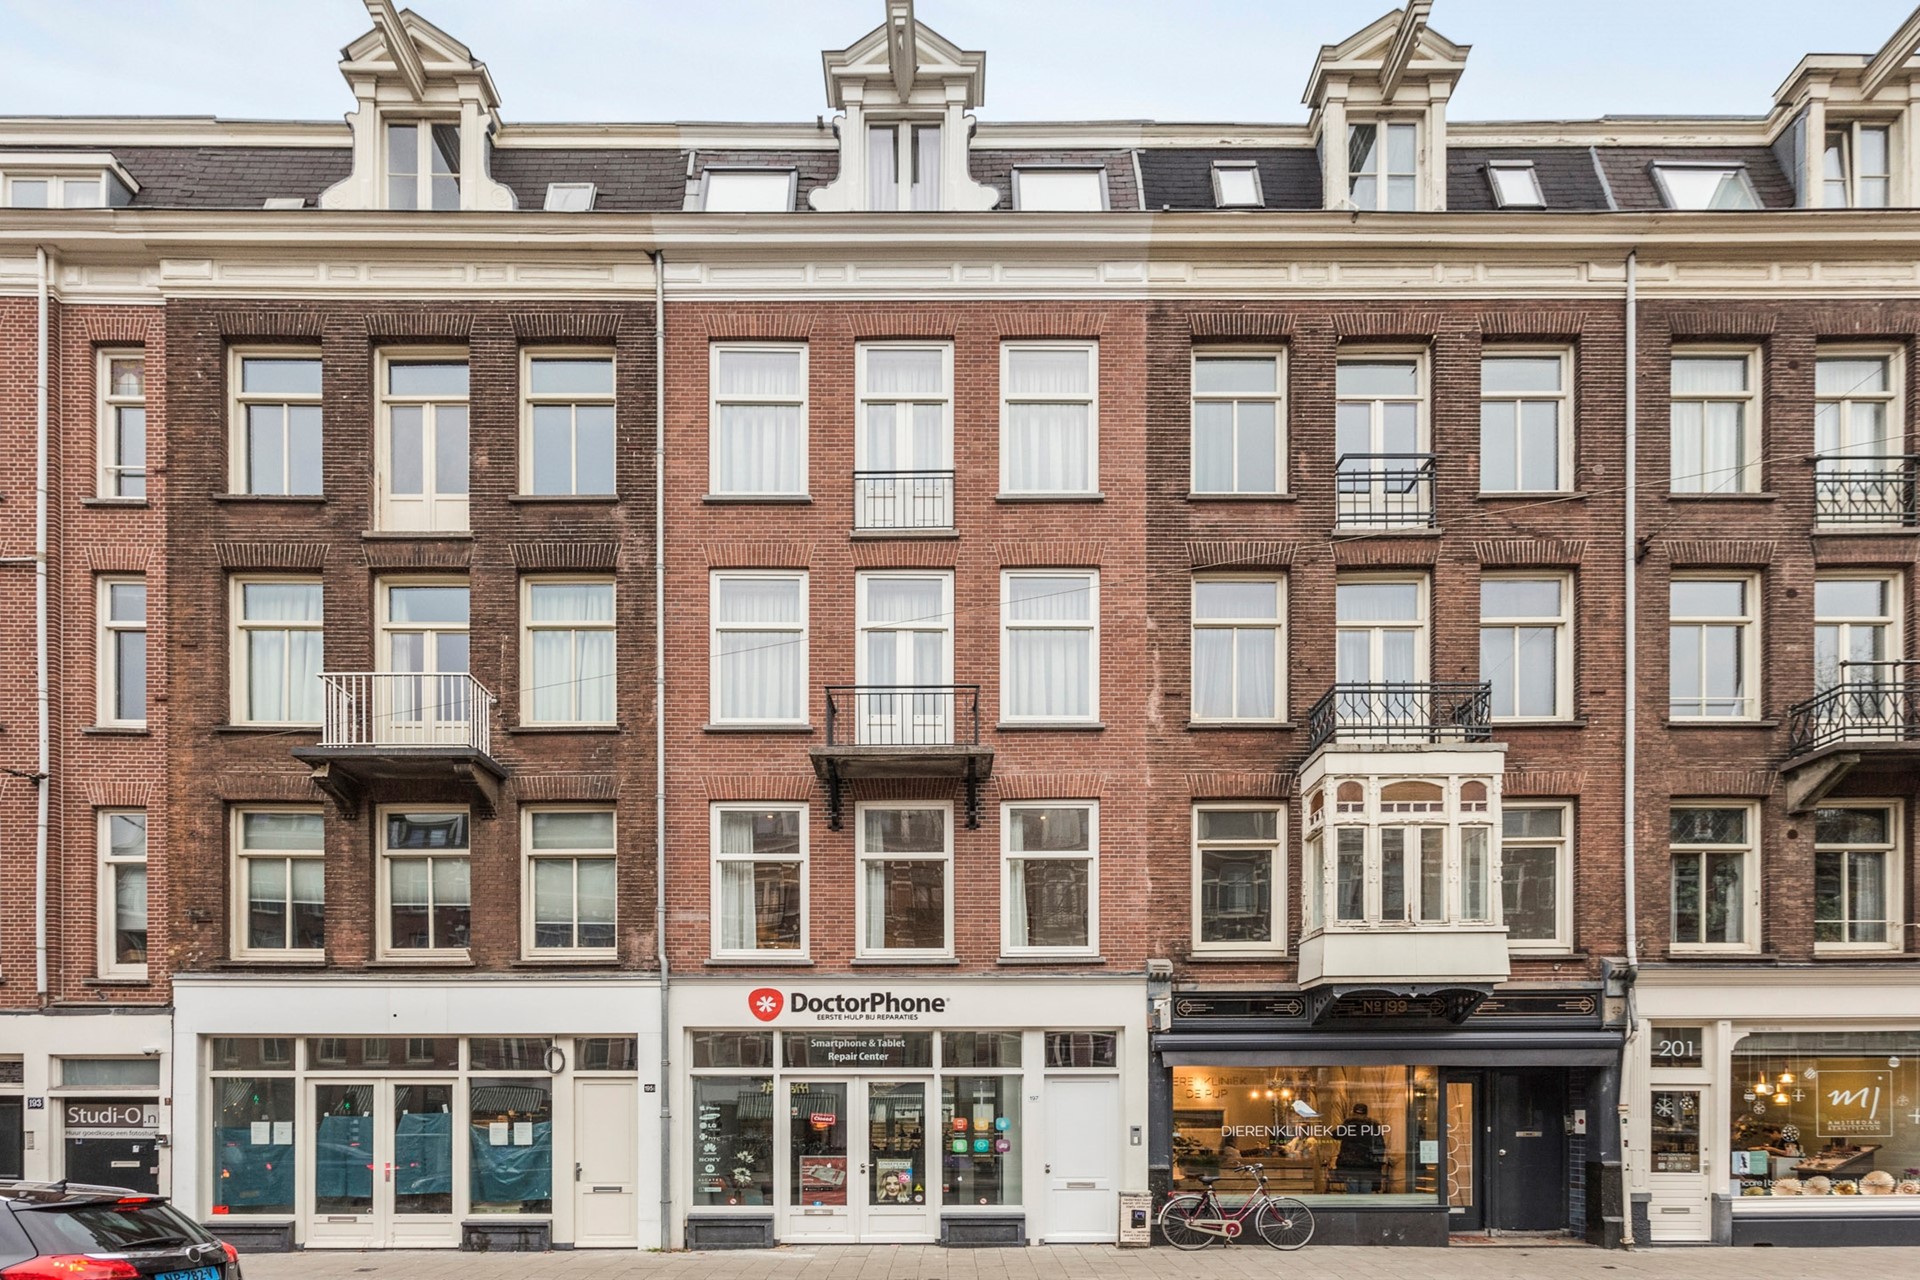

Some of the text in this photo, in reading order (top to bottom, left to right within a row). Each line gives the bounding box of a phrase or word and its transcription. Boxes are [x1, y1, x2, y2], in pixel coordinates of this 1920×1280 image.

[790, 991, 946, 1013] DoctorPhone
[1384, 1000, 1408, 1013] 199
[817, 1013, 918, 1021] EERSTE HULP BIJ REPARATIES
[810, 1038, 905, 1048] Smartphone & Tablet
[1659, 1040, 1693, 1057] 201
[828, 1052, 889, 1062] Repair Center
[1186, 1089, 1201, 1099] DE
[28, 1098, 43, 1108] 193
[1221, 1125, 1391, 1137] DIERENKLINIEK DE PIJP
